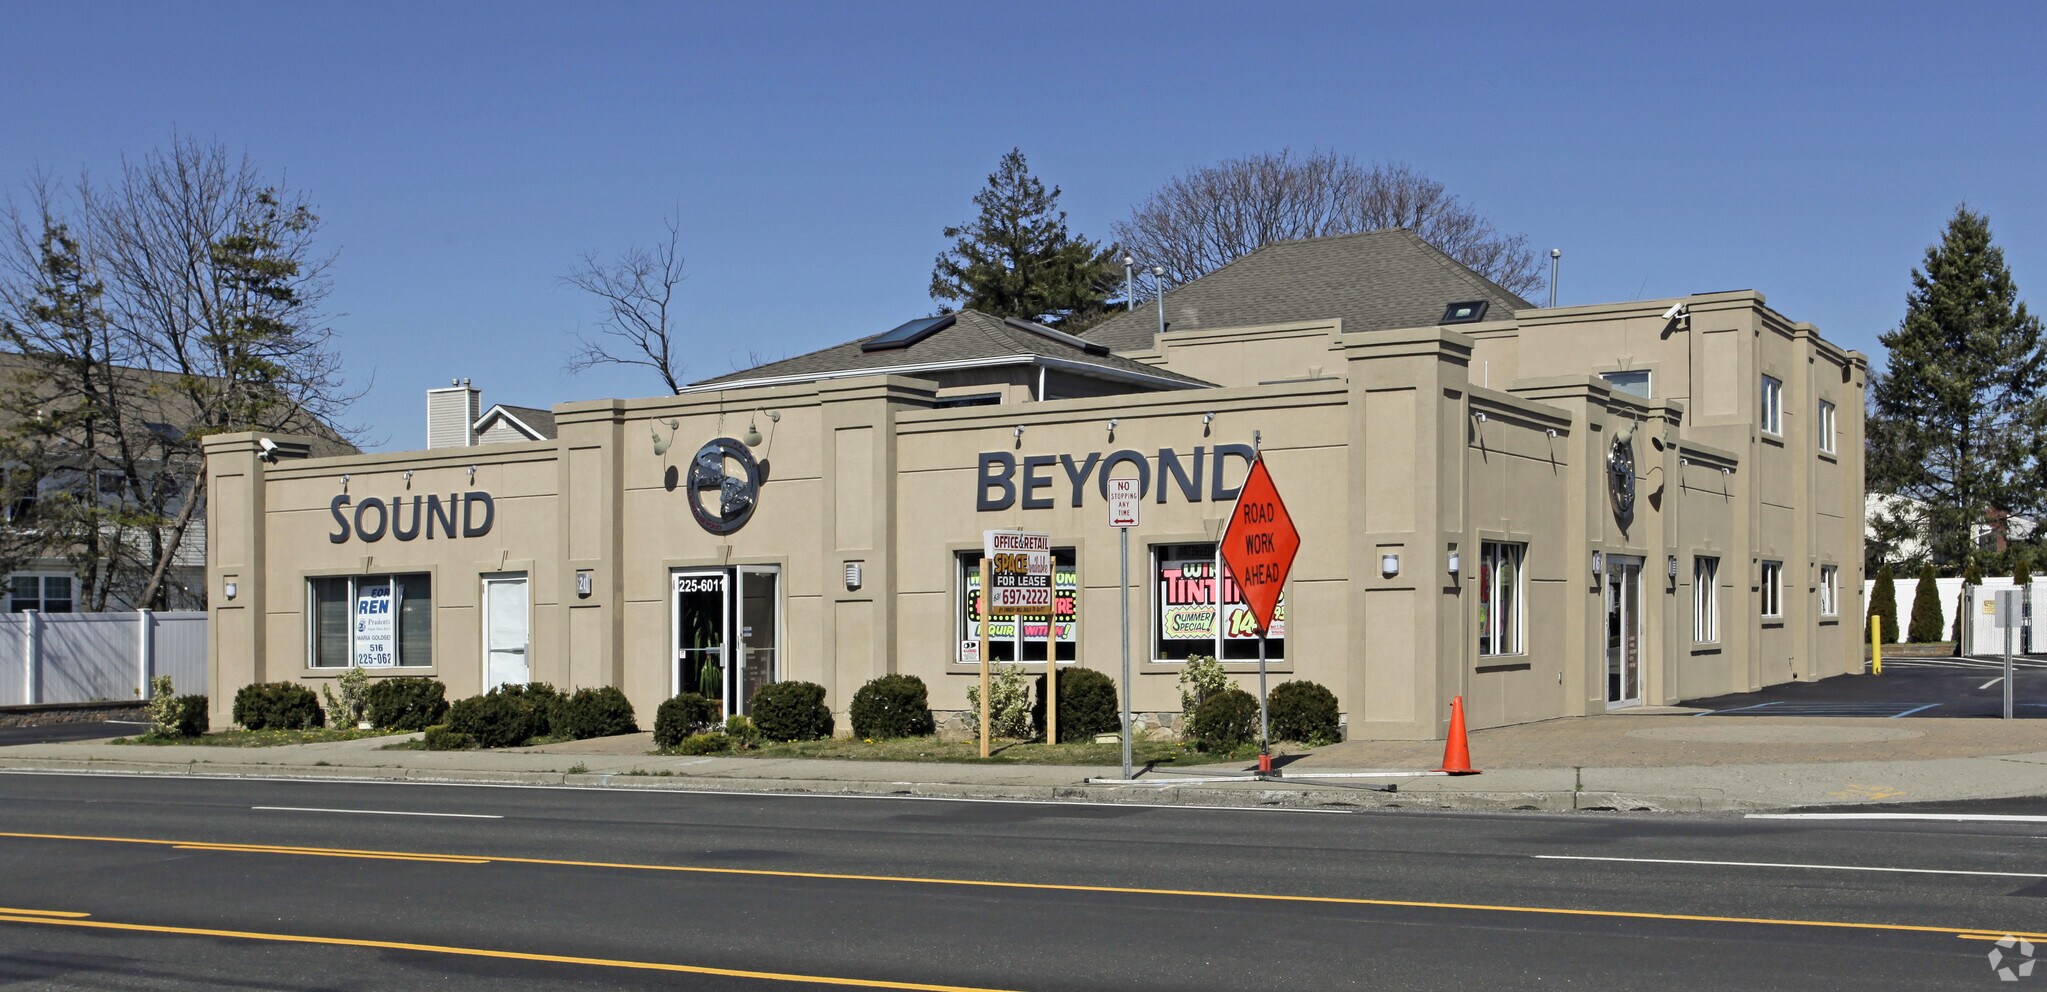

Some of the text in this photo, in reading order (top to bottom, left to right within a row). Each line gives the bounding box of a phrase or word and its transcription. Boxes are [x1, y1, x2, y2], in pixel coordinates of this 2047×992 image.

[976, 444, 1256, 512] BEYOND
[1117, 481, 1130, 490] NO
[1111, 492, 1137, 500] STOPPING
[329, 491, 495, 544] SOUND
[1118, 509, 1130, 517] TIME
[1244, 503, 1274, 525] ROAD
[1245, 533, 1275, 555] WORK
[994, 553, 1027, 573] SPACE
[997, 576, 1046, 586] FOR LEASE
[1244, 563, 1280, 587] AHEAD
[679, 579, 724, 592] 225-6011
[371, 588, 390, 598] FOR
[359, 600, 389, 614] REN
[1173, 613, 1211, 627] SUMMER
[369, 644, 383, 652] 516
[358, 654, 391, 664] 225-062
